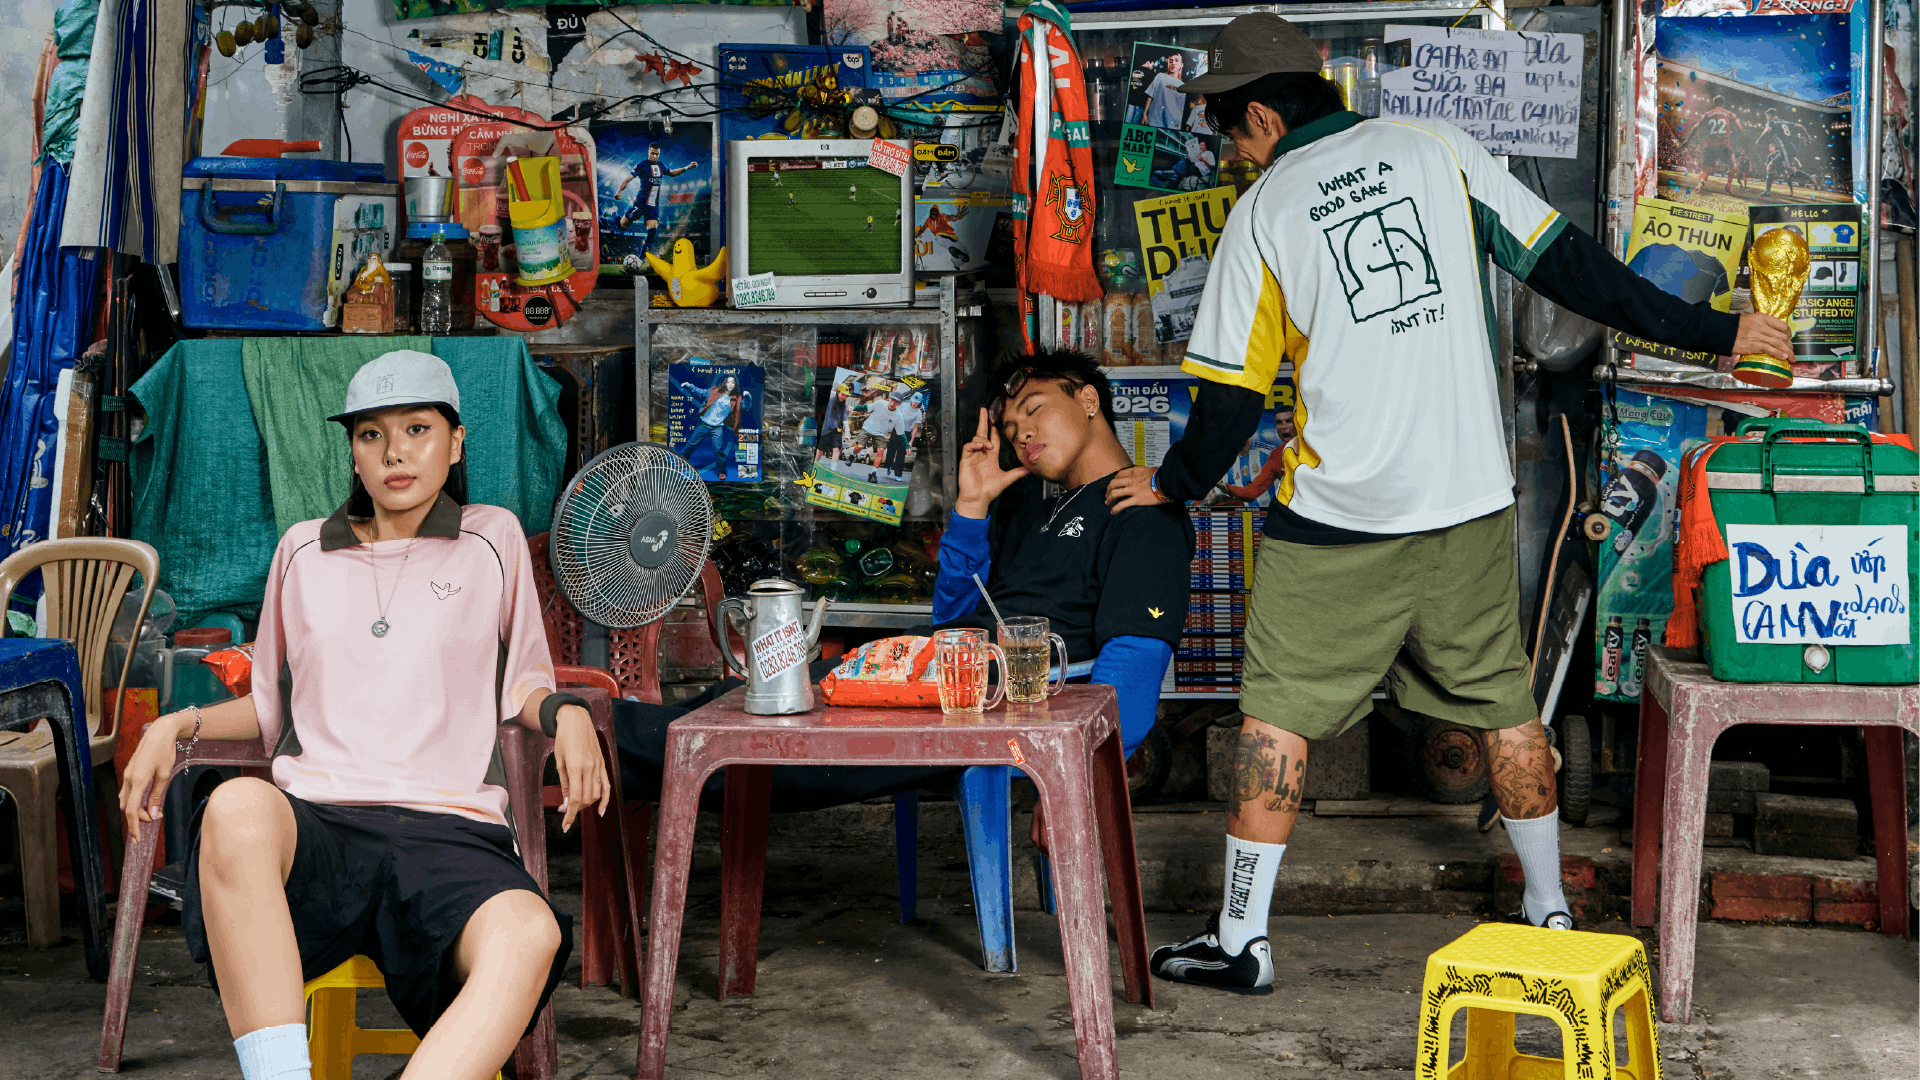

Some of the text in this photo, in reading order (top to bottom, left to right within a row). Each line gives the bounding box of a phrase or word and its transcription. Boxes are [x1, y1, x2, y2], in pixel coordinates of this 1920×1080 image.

[1708, 118, 1727, 135] 22
[1781, 123, 1791, 137] 8
[1124, 127, 1154, 145] ABC
[1122, 141, 1152, 155] MART
[1318, 161, 1393, 196] WHAT A
[1309, 181, 1388, 221] GOOD GAME
[1678, 225, 1733, 251] THUN
[1795, 298, 1855, 308] BASIC ANGEL
[1793, 308, 1855, 318] STUFFED TOY
[1120, 381, 1168, 395] THI ĐẤU
[1112, 396, 1170, 414] 026
[753, 620, 800, 654] WHAT IT ISNT
[1228, 849, 1260, 921] WHAT IT ISNT
